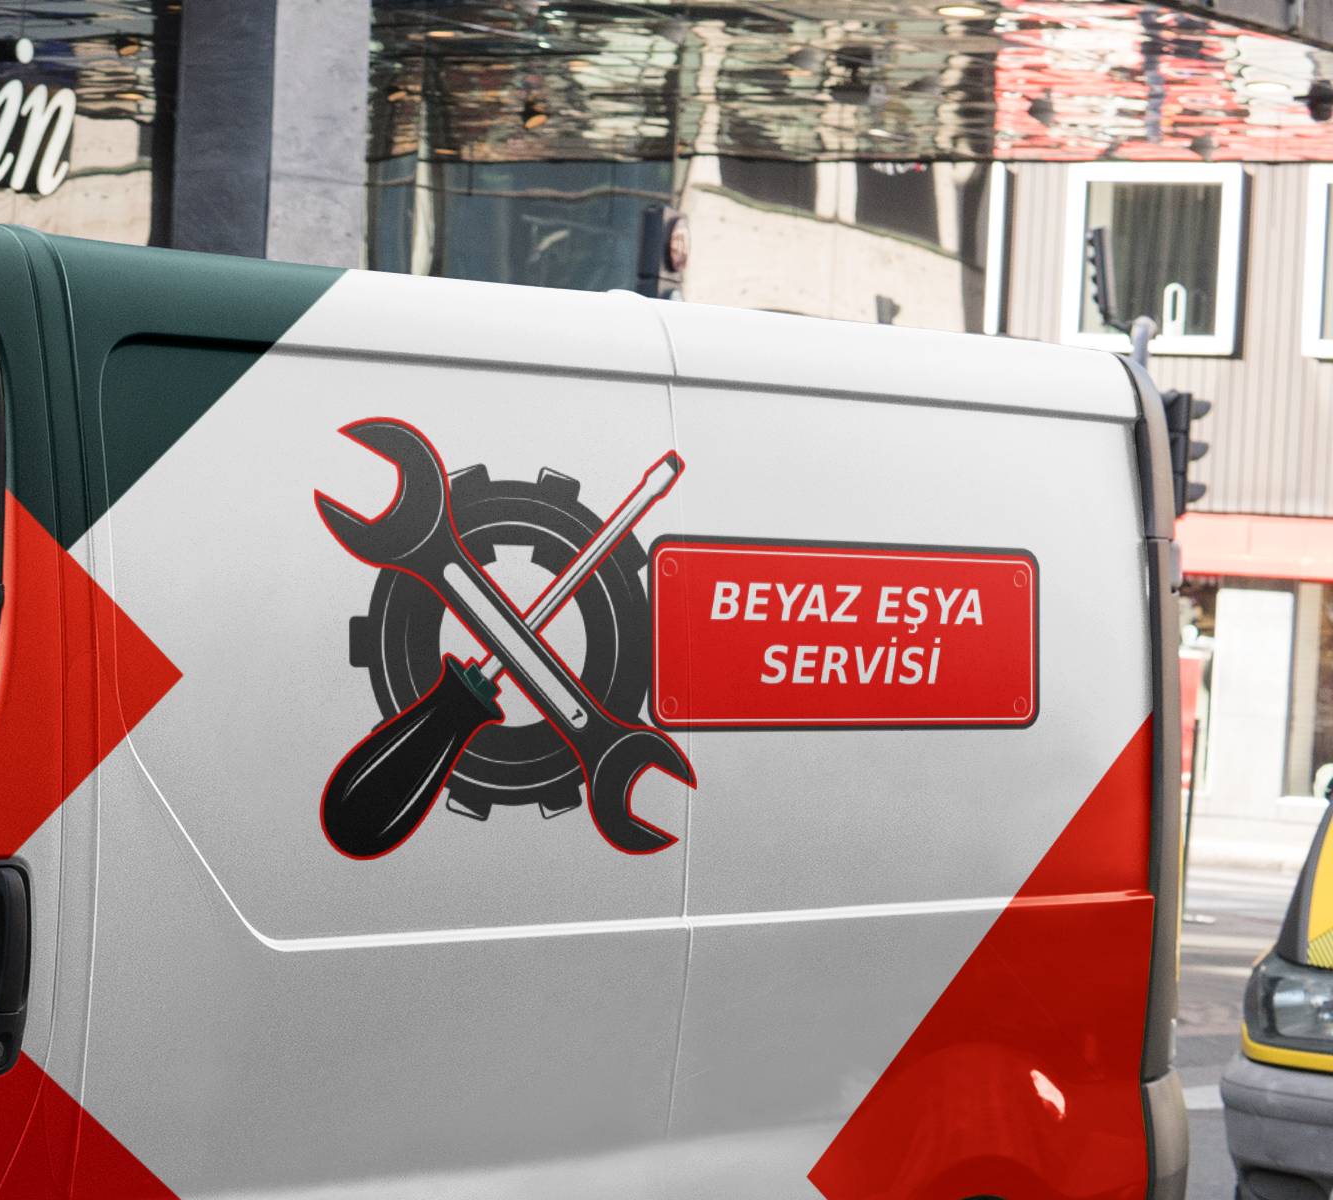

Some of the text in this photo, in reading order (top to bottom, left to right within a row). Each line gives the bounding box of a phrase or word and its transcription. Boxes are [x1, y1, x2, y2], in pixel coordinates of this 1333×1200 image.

[710, 581, 984, 634] BEYAZ EŞYA
[759, 636, 942, 684] SERVİSİ
